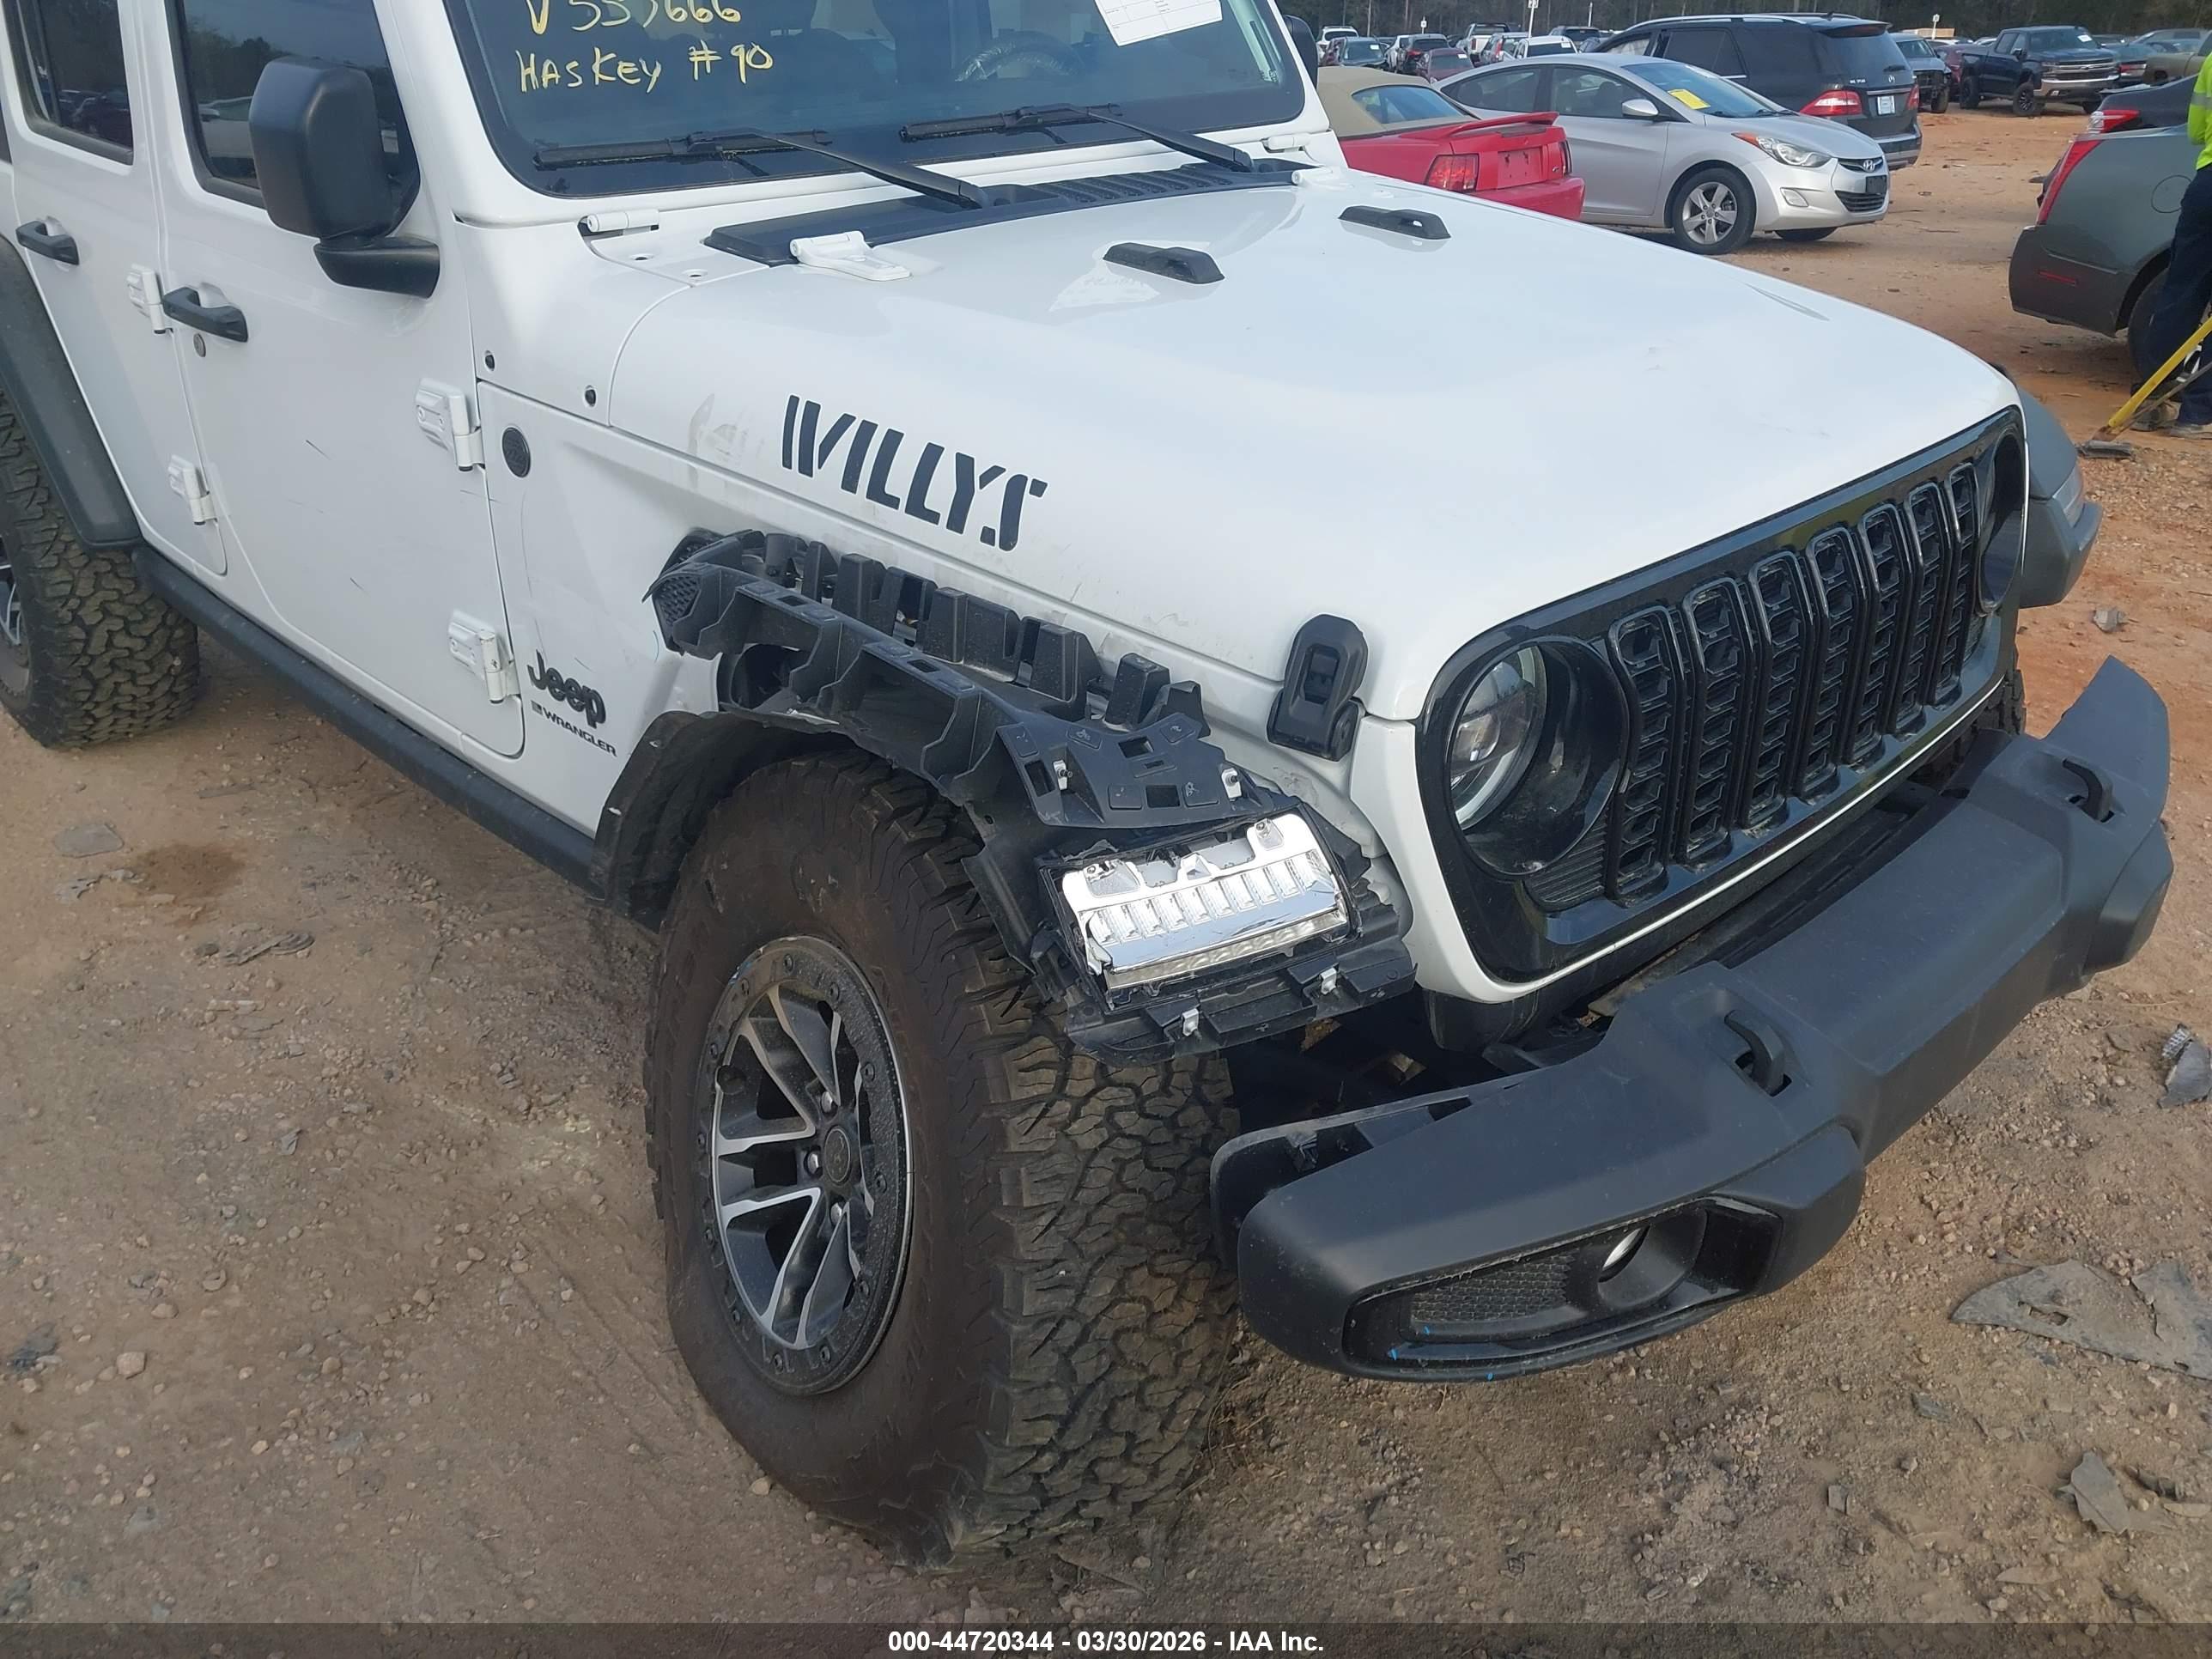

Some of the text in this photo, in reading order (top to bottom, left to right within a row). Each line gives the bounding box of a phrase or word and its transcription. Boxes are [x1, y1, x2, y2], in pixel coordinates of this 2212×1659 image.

[781, 394, 1048, 551] WILLYS
[526, 649, 606, 729] Jeep
[542, 707, 617, 757] WRANGLER
